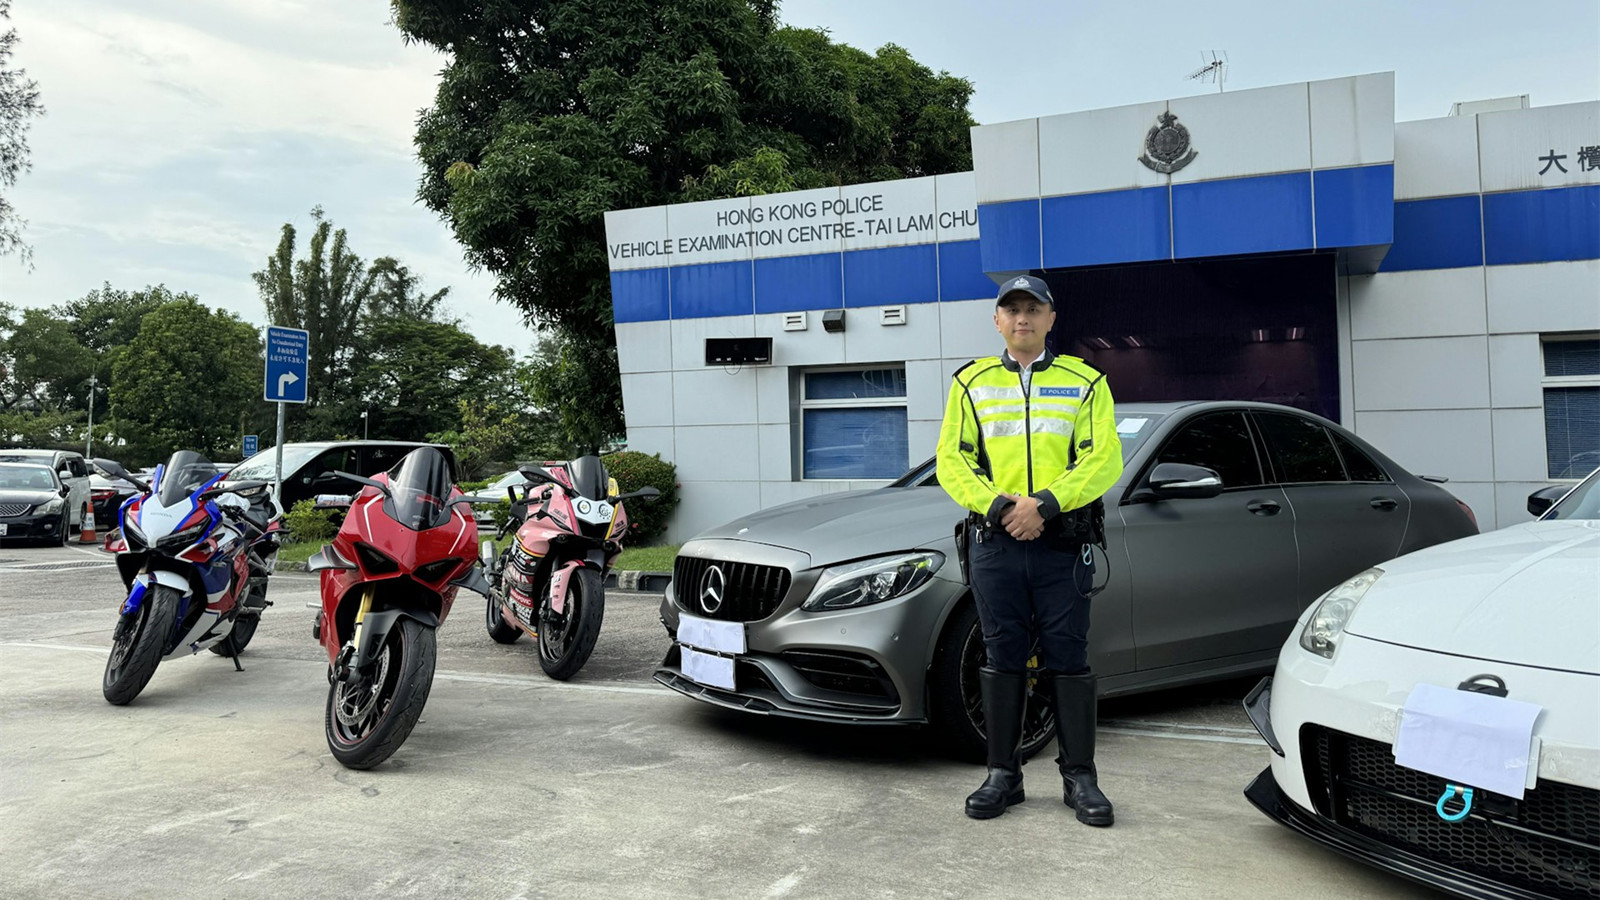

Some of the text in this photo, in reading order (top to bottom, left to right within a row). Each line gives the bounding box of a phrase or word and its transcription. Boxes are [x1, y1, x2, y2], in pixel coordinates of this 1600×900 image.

[716, 194, 884, 227] HONG KONG POLICE
[609, 239, 674, 259] VEHICLE
[678, 229, 782, 253] EXAMINATION
[897, 214, 934, 233] LAM
